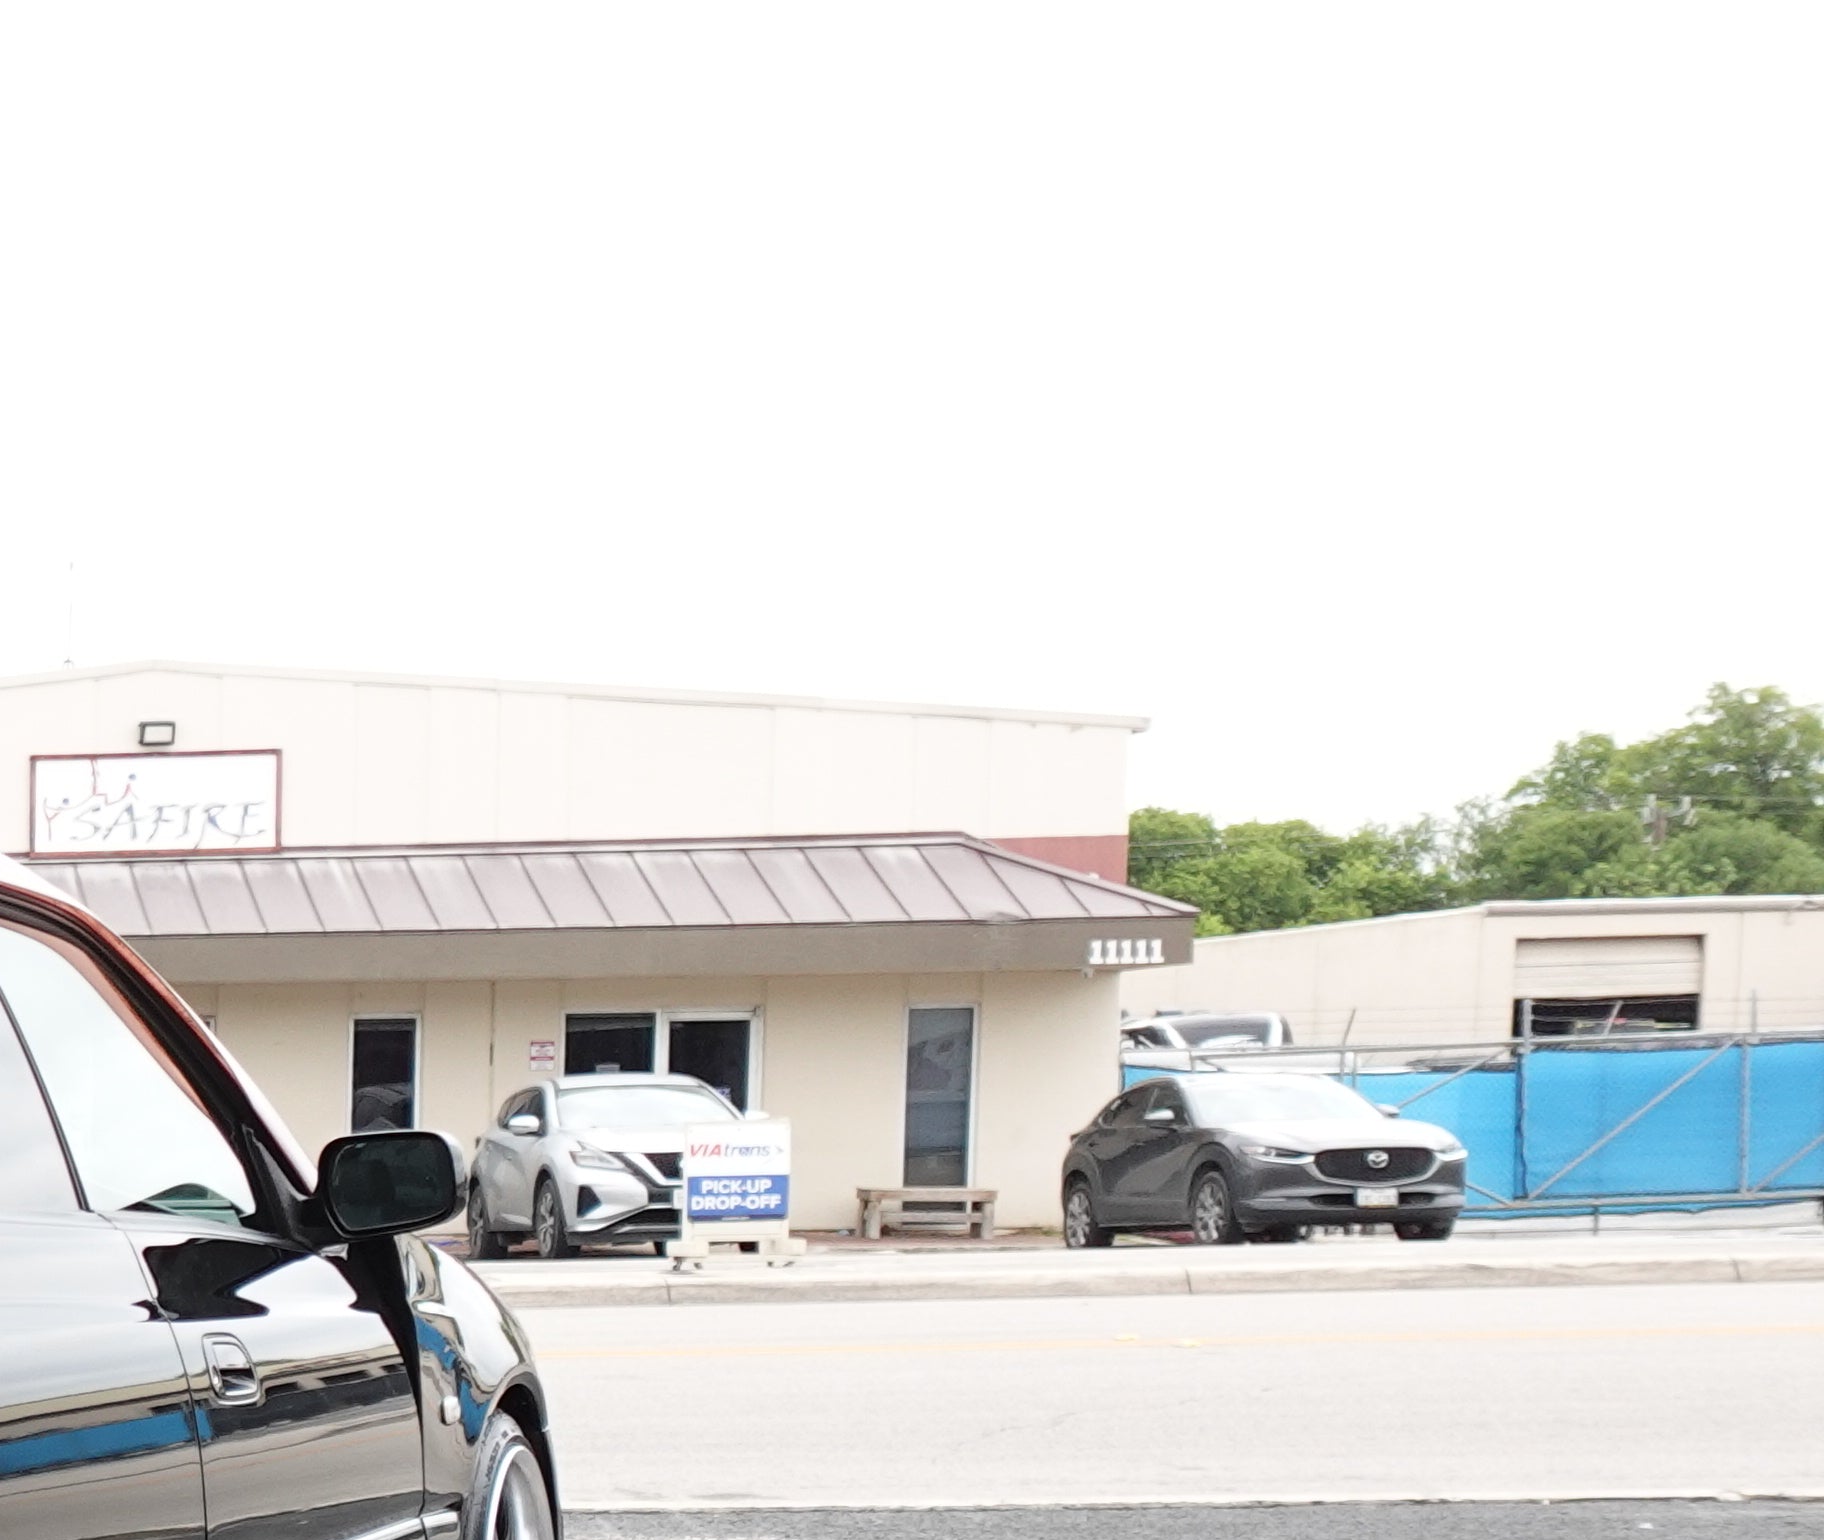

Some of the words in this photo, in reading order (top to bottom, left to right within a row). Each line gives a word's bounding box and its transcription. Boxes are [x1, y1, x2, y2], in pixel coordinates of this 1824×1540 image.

[70, 801, 266, 849] SAFIRE
[1089, 938, 1165, 965] 11111
[701, 1179, 772, 1194] PICK-UP
[691, 1193, 782, 1210] DROP-OFF
